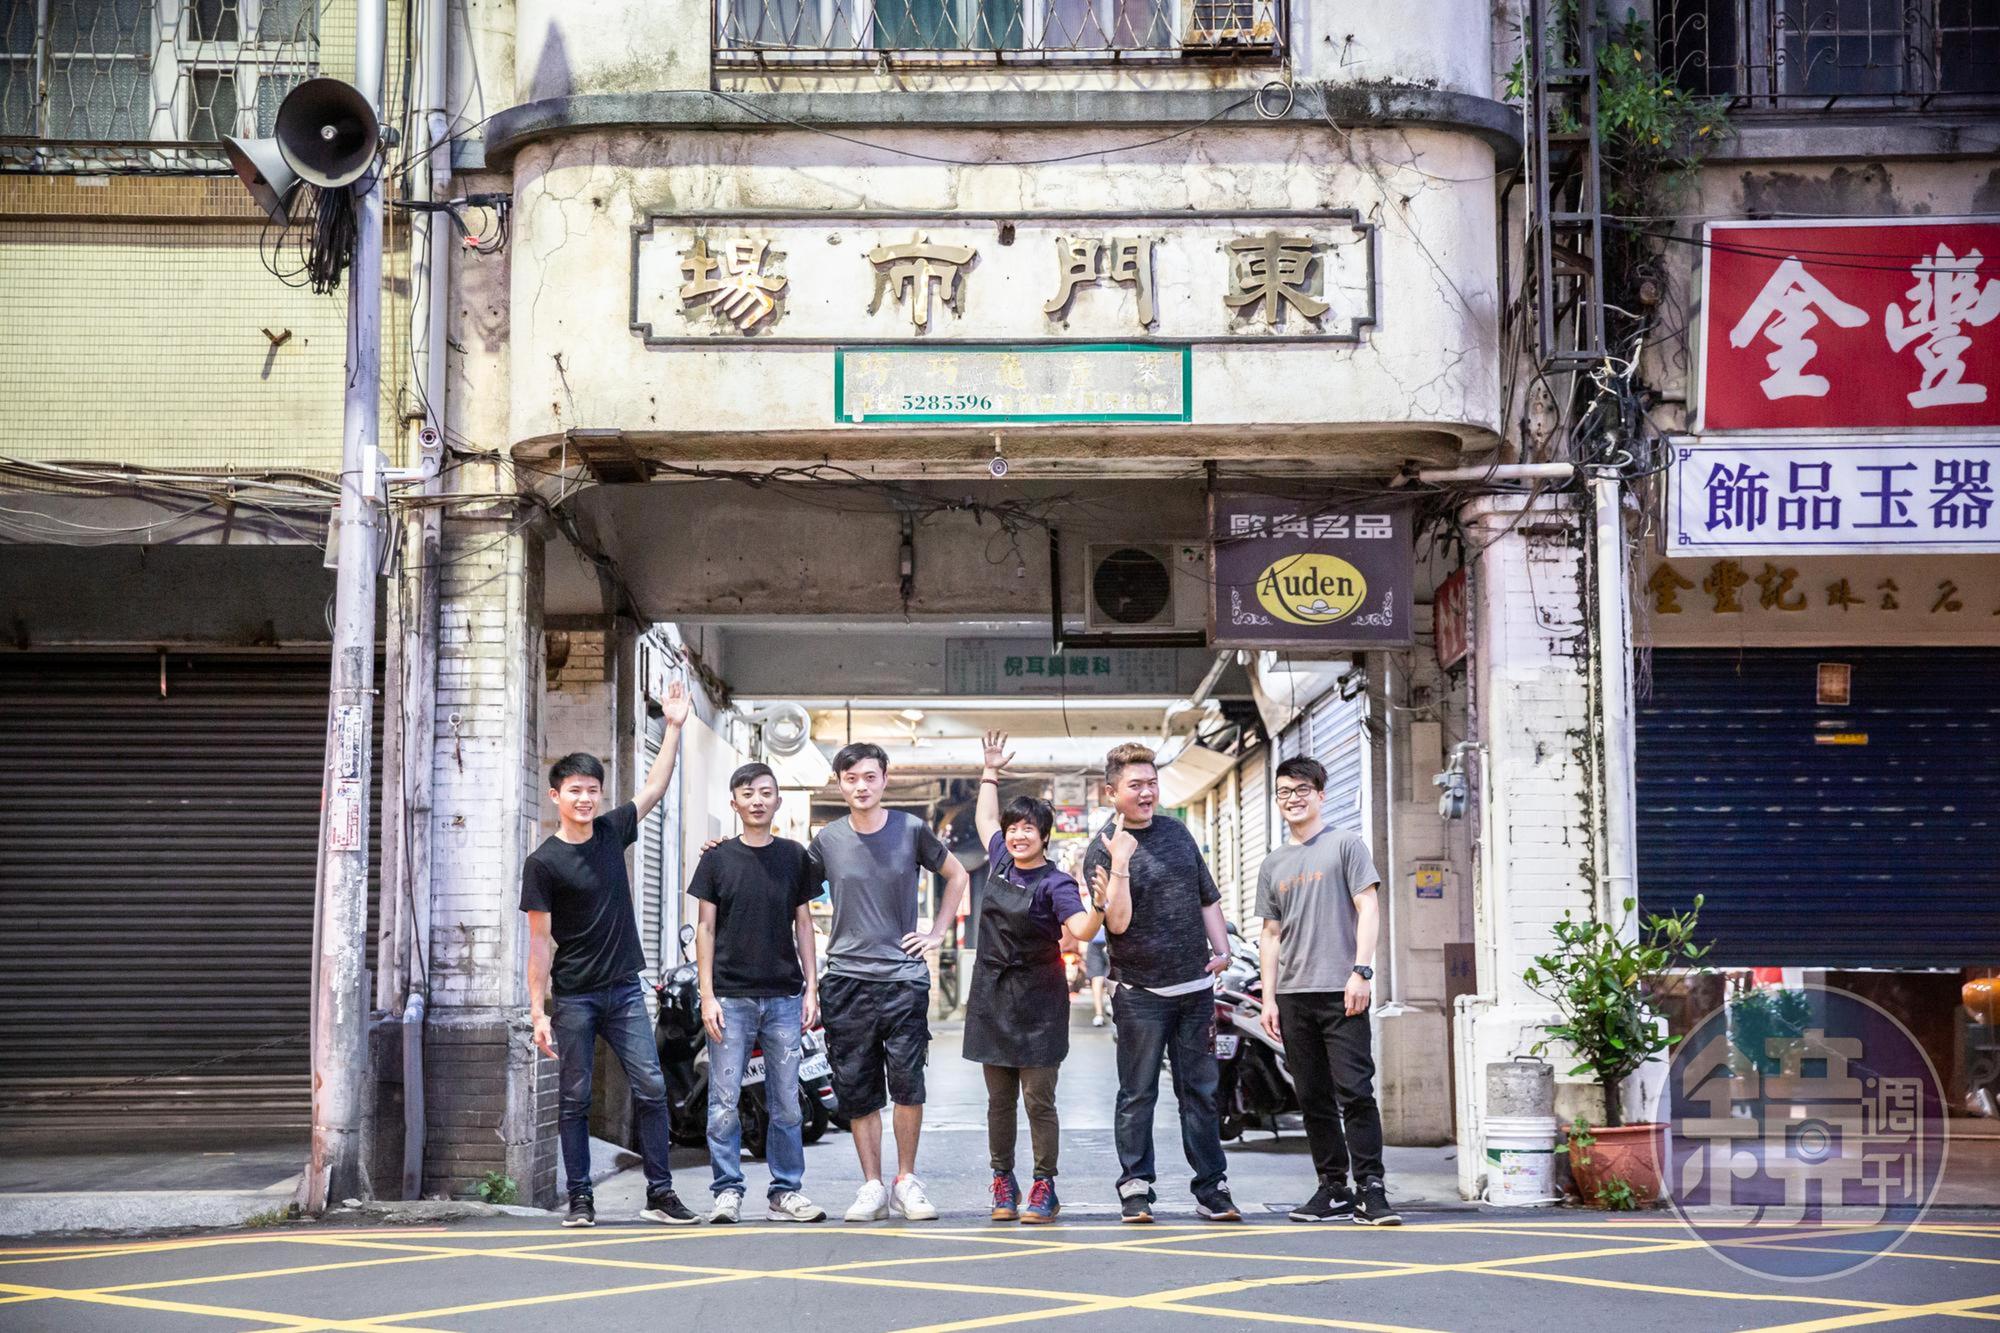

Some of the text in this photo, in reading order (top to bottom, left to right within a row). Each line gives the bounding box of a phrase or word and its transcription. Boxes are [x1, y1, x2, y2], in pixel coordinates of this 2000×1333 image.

[902, 394, 992, 411] 5285596
[1703, 459, 1994, 533] 飾品玉器
[1261, 566, 1357, 602] Auden
